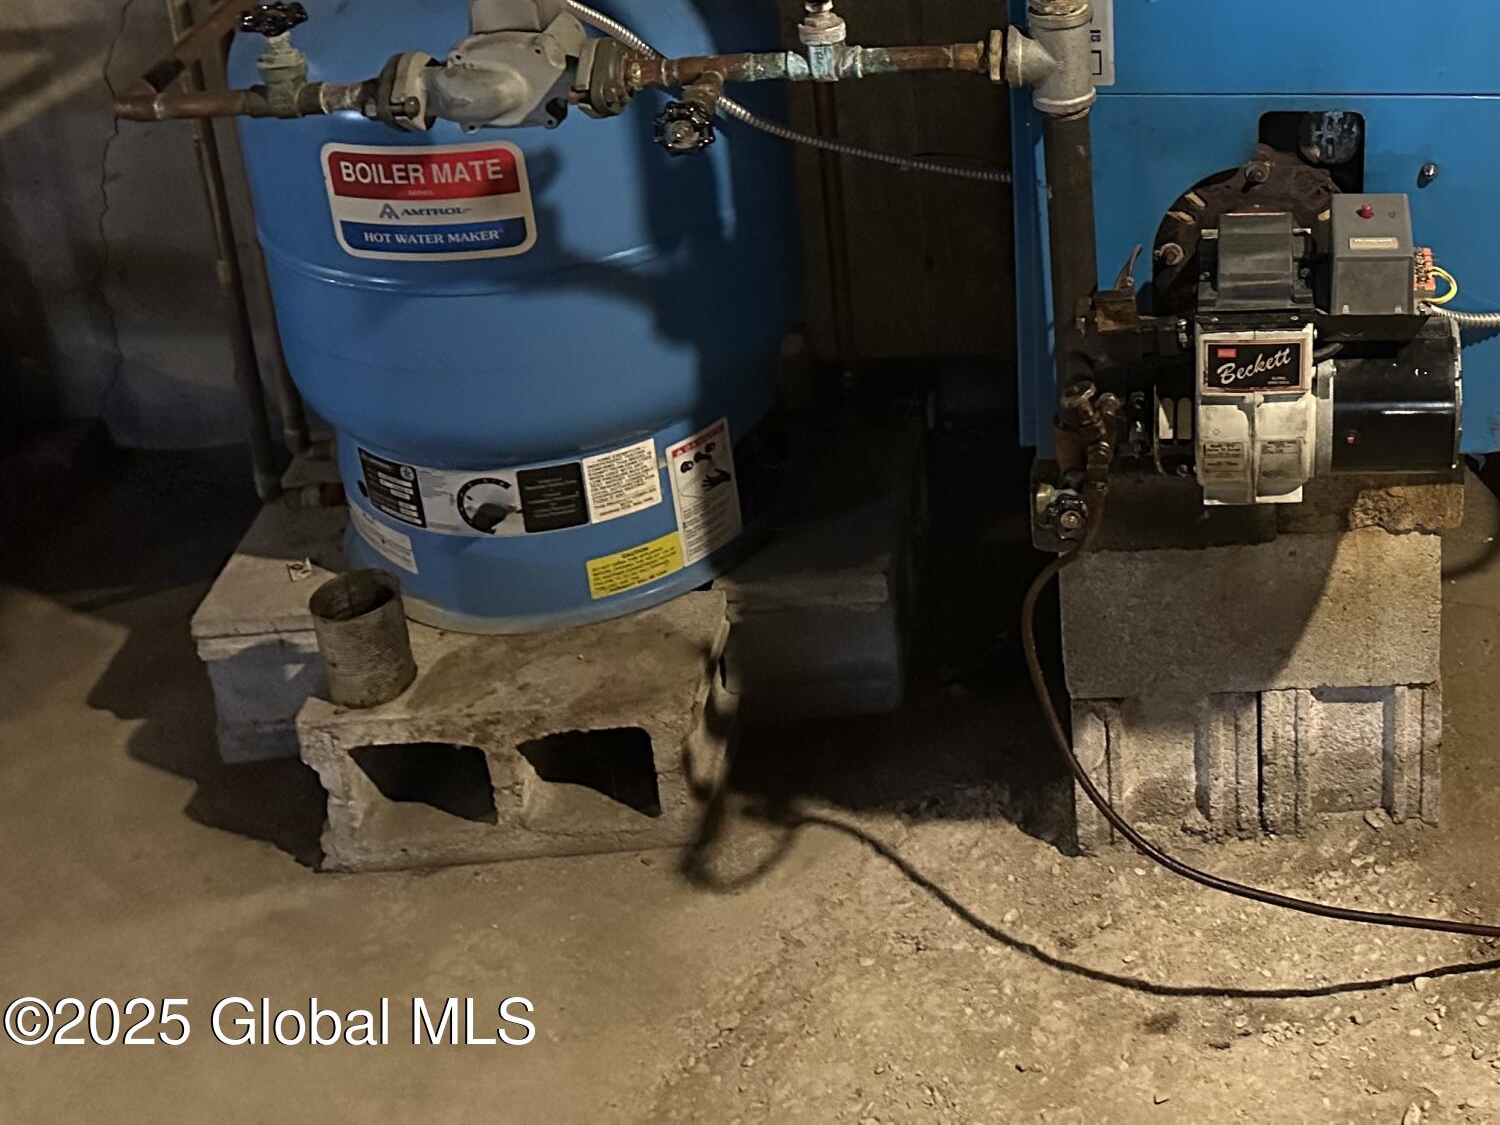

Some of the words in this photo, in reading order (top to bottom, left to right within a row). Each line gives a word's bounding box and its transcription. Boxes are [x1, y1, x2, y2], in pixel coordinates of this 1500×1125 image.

[339, 161, 425, 185] BOILER
[431, 159, 503, 184] MATE
[401, 207, 466, 217] AMTROL
[363, 232, 391, 244] HOT
[395, 234, 444, 245] WATER
[1216, 347, 1291, 385] Beckett
